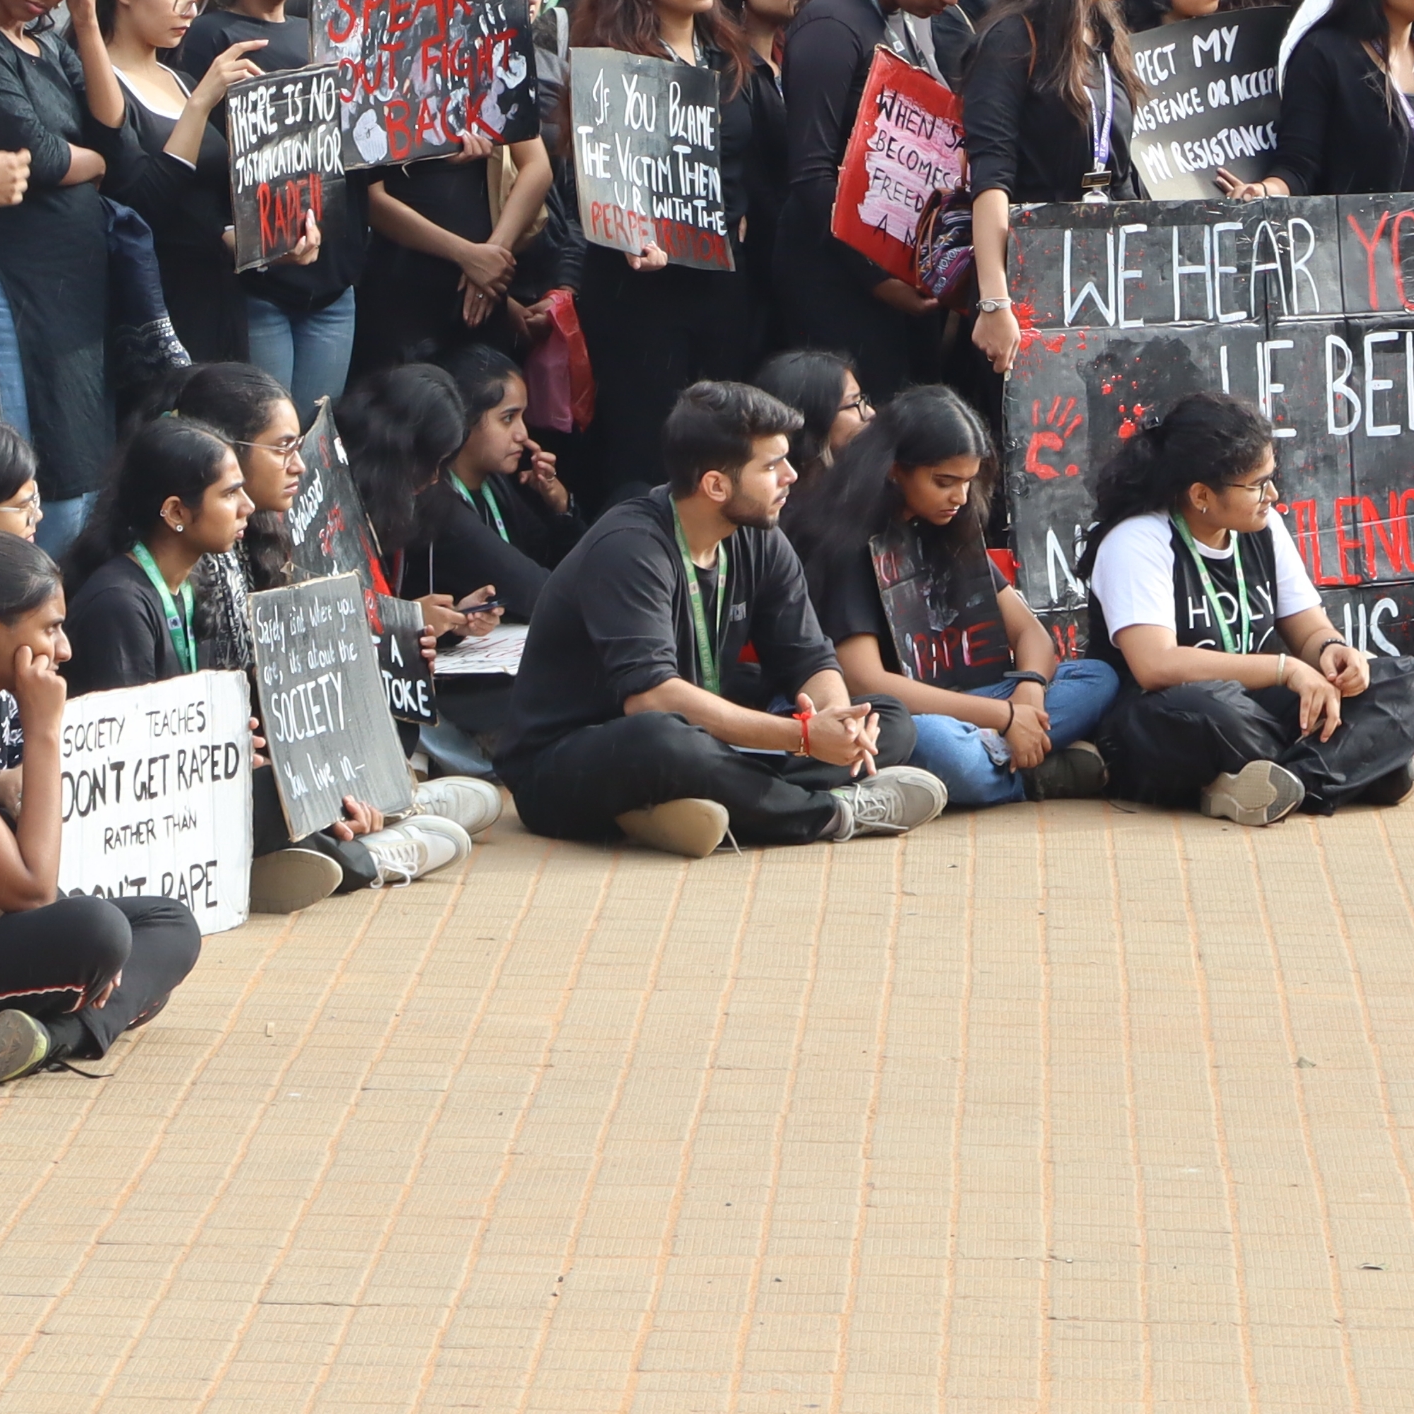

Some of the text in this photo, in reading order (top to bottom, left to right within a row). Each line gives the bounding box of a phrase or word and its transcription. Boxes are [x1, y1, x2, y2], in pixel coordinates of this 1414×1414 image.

[421, 30, 519, 89] FIGHT
[1133, 24, 1239, 86] PECT MY
[229, 73, 335, 156] THERE IS NO
[385, 95, 504, 160] BACK
[593, 68, 715, 151] IF YOU BLAME
[878, 85, 935, 140] WHEN
[1132, 88, 1204, 138] XISTENCE
[1207, 78, 1230, 108] OR
[236, 127, 343, 194] JUSTIFICATION FOR
[577, 126, 722, 204] THE VICTIM THEN
[875, 130, 952, 190] BECOMES
[1141, 141, 1173, 184] MY
[591, 200, 730, 268] PERPETRATOR
[653, 195, 692, 224] WITH
[692, 200, 727, 236] THE
[1063, 223, 1148, 328] WE
[1172, 218, 1321, 324] HEAR
[256, 604, 286, 654] Safety
[308, 596, 333, 628] where
[336, 596, 356, 633] you
[1188, 580, 1276, 629] HOLY
[338, 639, 358, 663] the
[391, 633, 404, 669] A
[913, 620, 1008, 679] RAPE
[271, 671, 345, 744] SOCIETY
[382, 669, 432, 718] JOKE
[62, 700, 207, 759] SOCIETY TEACHES
[60, 741, 240, 824] DON'T GET RAPED
[284, 760, 309, 801] You
[306, 752, 335, 791] live
[104, 809, 198, 855] RATHER THAN
